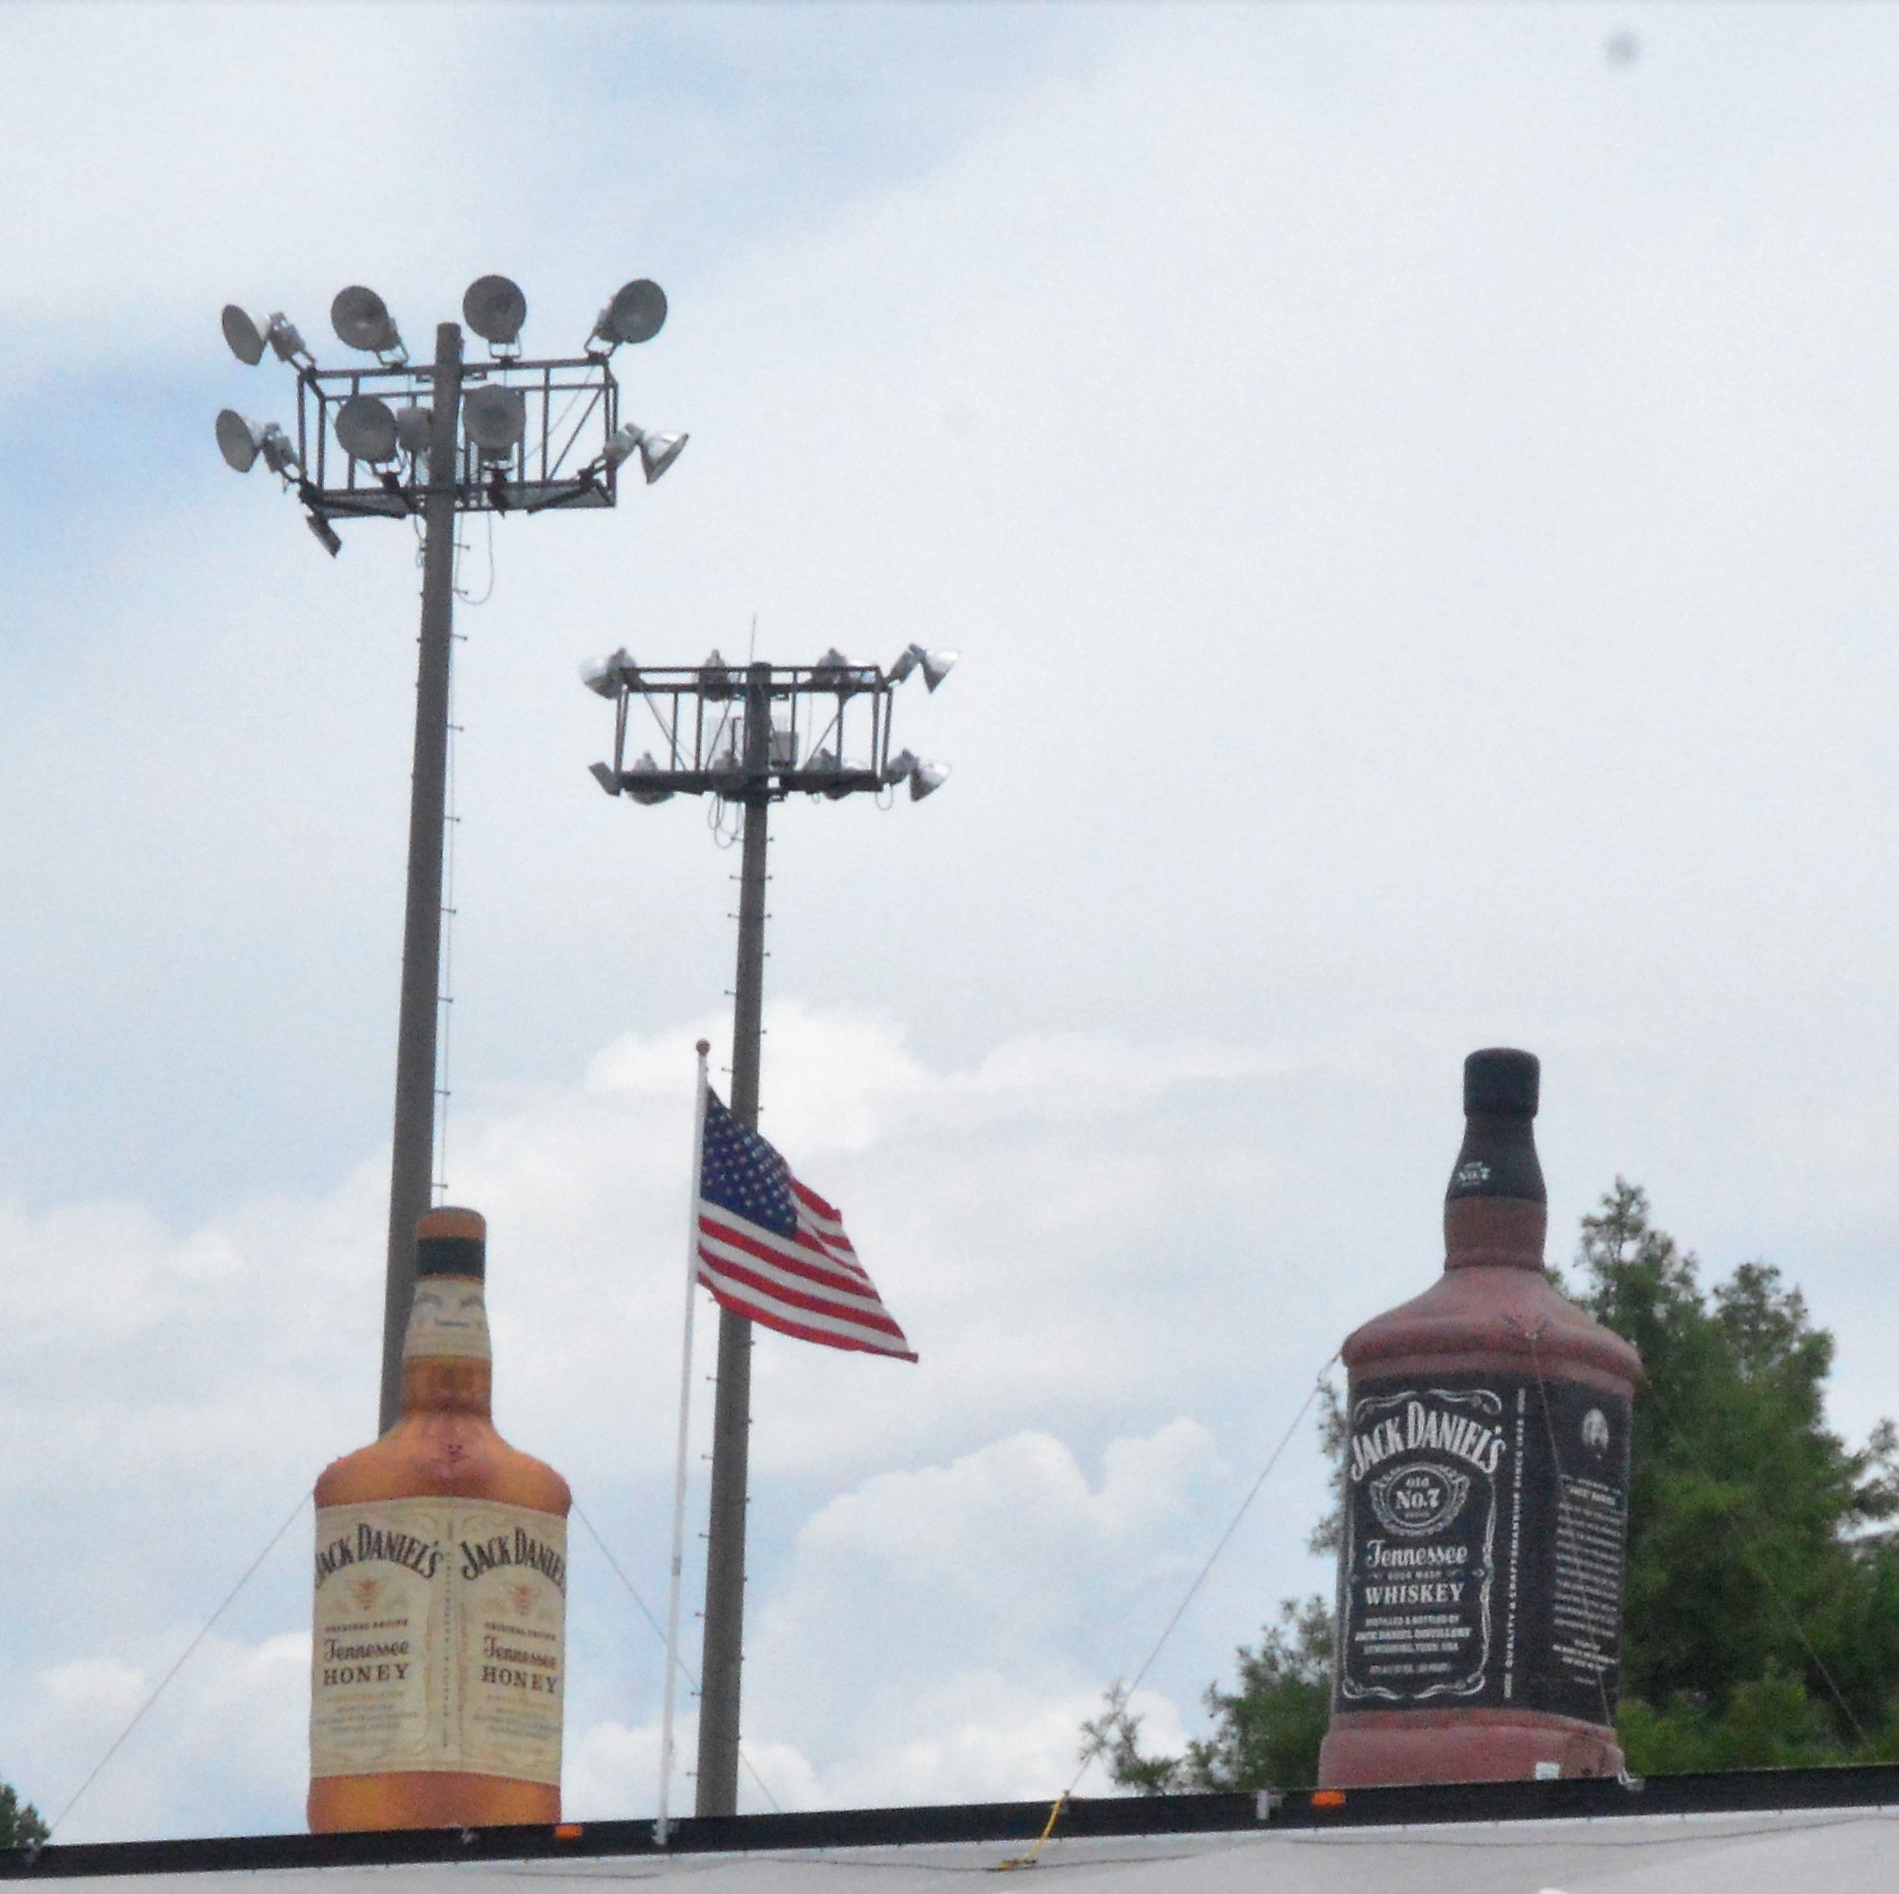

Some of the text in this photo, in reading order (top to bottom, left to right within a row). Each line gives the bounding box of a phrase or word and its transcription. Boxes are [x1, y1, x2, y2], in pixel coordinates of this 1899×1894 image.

[1351, 1400, 1507, 1482] JACK DANIEL'S
[357, 1522, 443, 1579] DANIEL'S
[459, 1534, 511, 1581] JACK
[1365, 1539, 1469, 1568] Tennessee
[1365, 1582, 1465, 1605] WHISKEY
[323, 1638, 409, 1662] Tennessee
[323, 1663, 410, 1686] HONEY
[481, 1665, 558, 1694] HONEY
